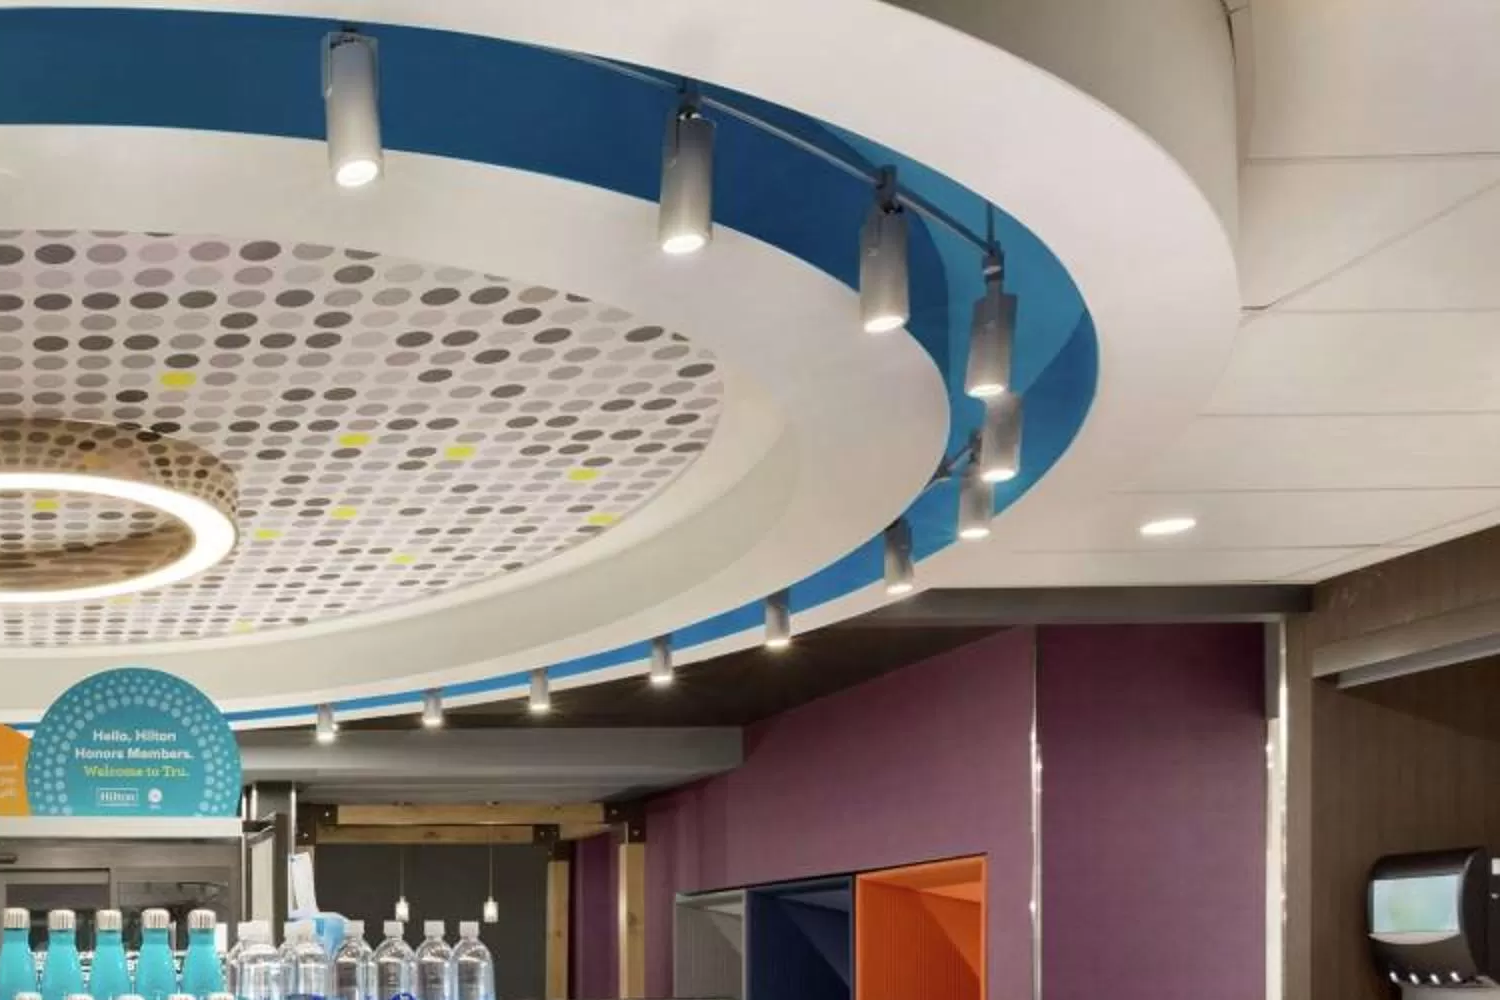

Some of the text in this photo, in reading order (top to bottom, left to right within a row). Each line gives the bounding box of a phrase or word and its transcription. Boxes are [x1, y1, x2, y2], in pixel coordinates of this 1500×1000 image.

[92, 729, 177, 744] Hello, Hilton
[75, 747, 195, 760] Honors Members.
[84, 765, 143, 778] Welcome
[146, 767, 160, 777] to
[100, 791, 136, 801] Hilton
